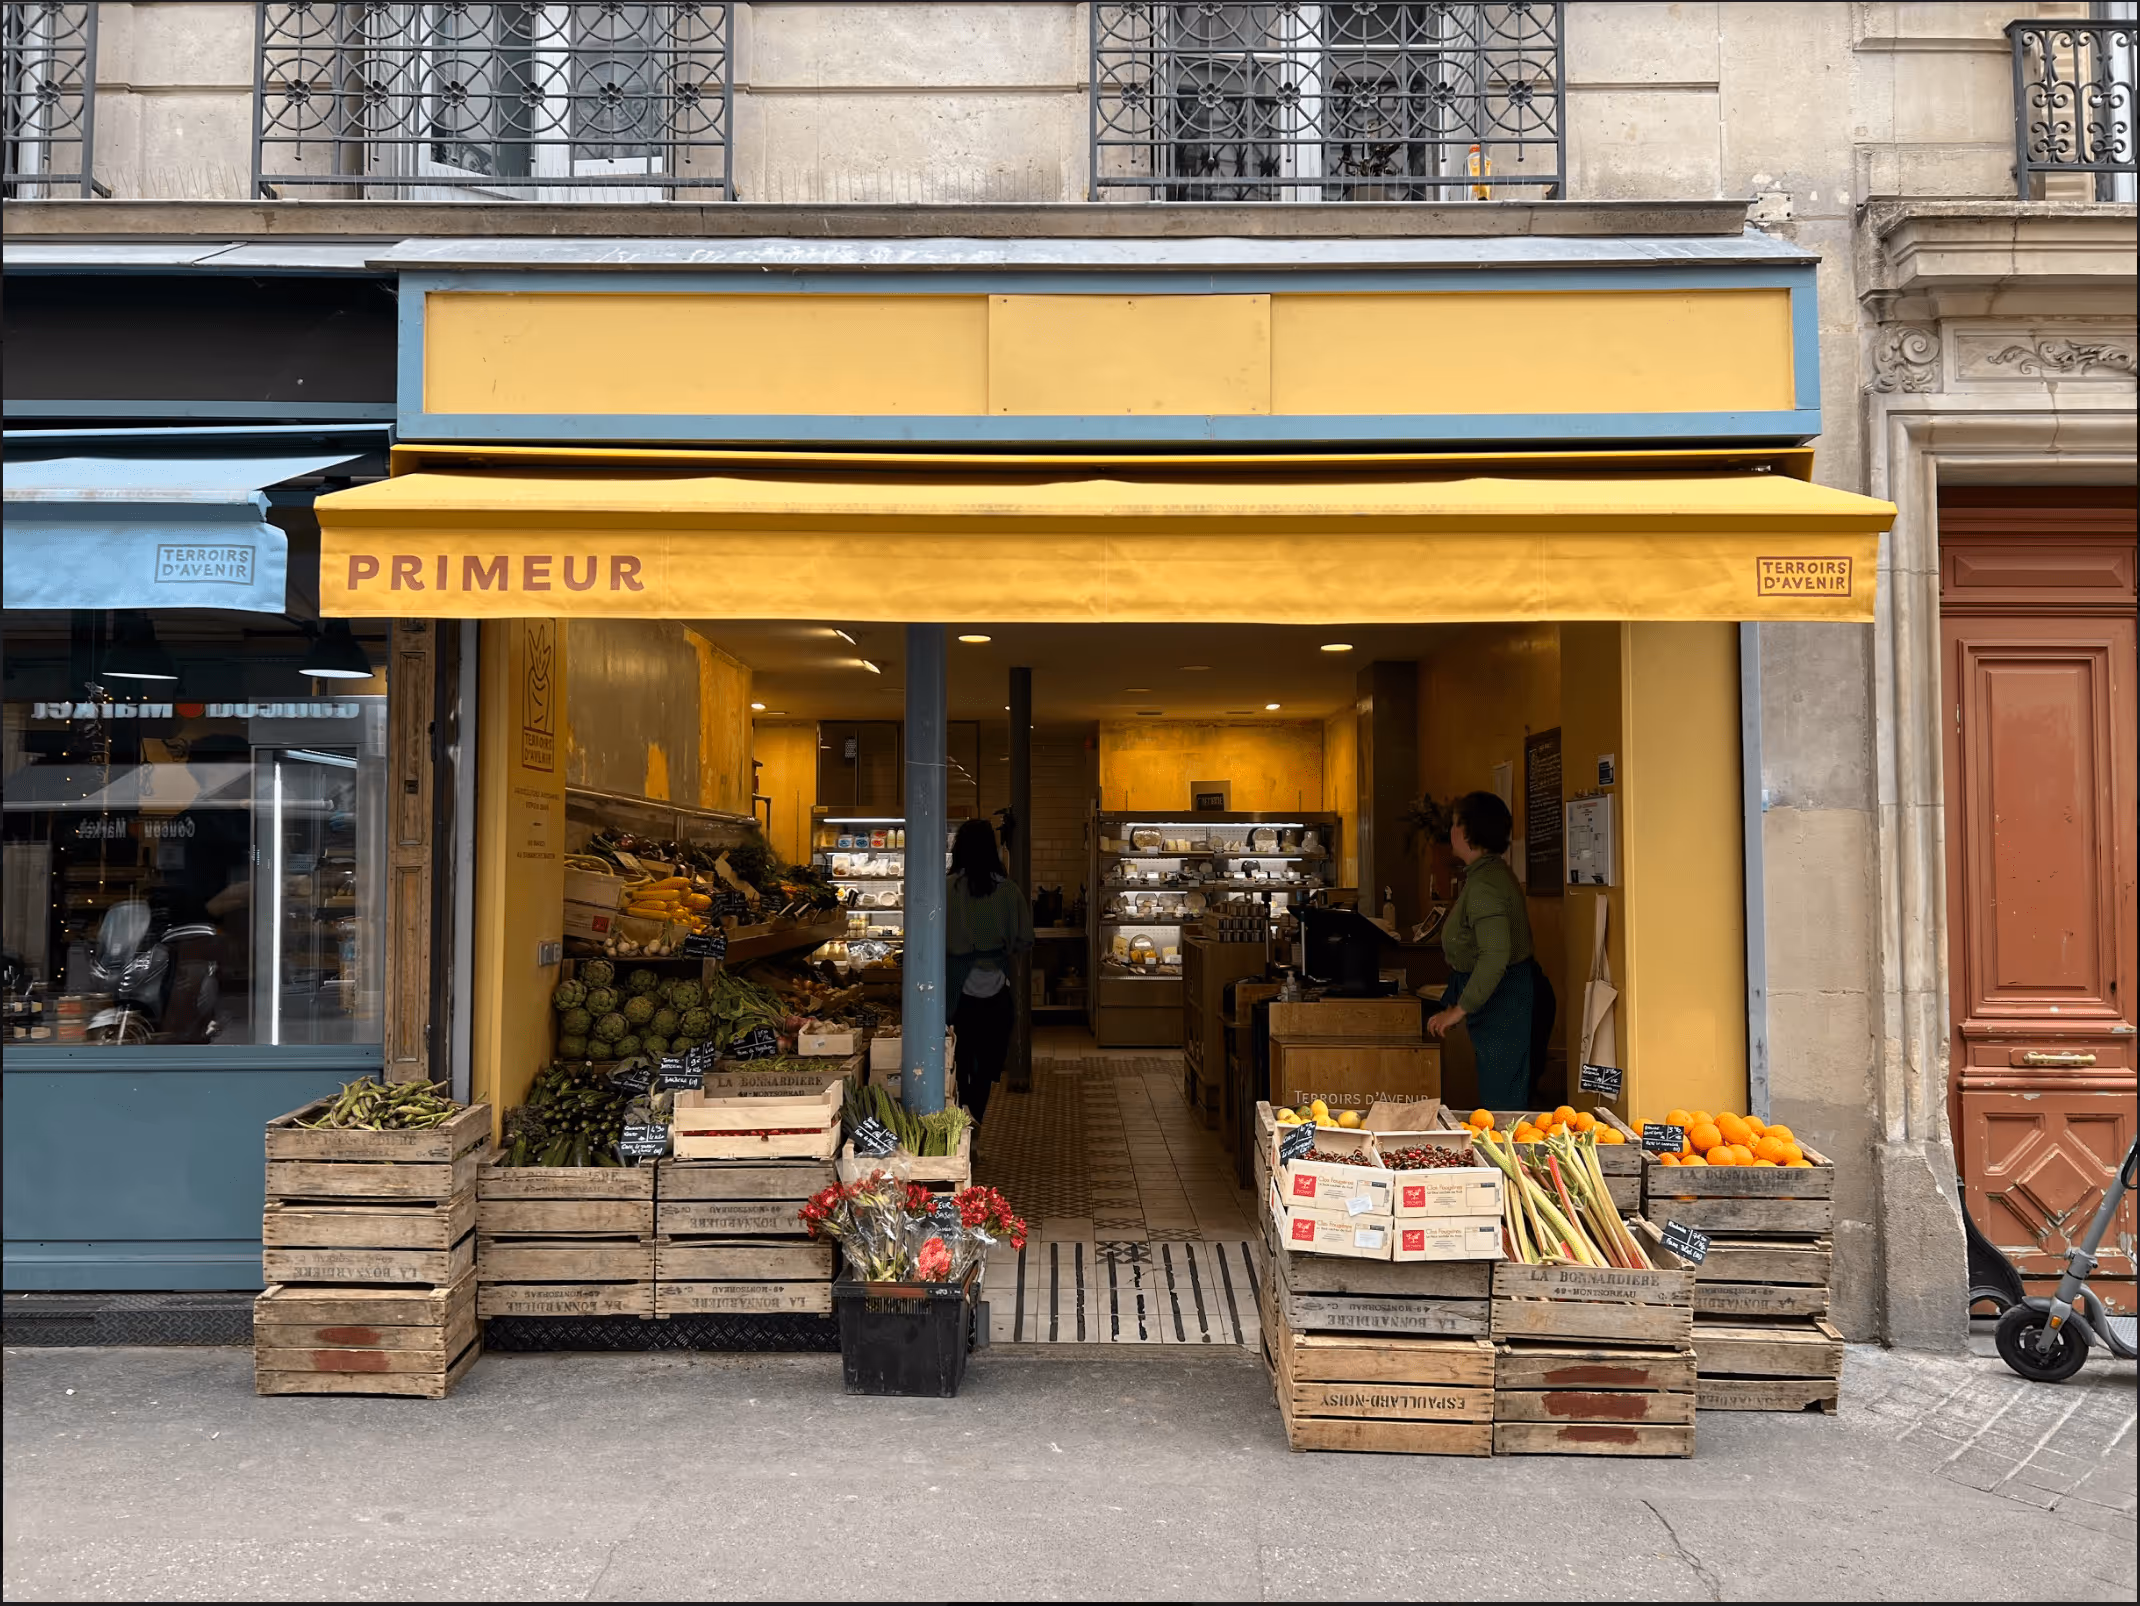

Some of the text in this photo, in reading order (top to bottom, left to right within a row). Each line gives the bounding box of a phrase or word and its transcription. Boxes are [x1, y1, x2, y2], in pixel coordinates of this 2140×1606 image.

[163, 549, 250, 563] TERROIRS
[162, 563, 247, 578] D'AVENIR
[347, 555, 645, 592] PRIMEUR
[1762, 561, 1847, 575] TERROIRS
[1763, 576, 1846, 590] D'AVENIR
[716, 1077, 733, 1088] LA
[1530, 1269, 1660, 1287] LA BONNARDIERE
[1554, 1287, 1637, 1299] 49-MONTSOREAU
[691, 1296, 806, 1309] LA BONNARDIERE
[1328, 1314, 1457, 1330] LA BONNARDIERE
[1321, 1393, 1466, 1410] ESPAULLARD-NOISY
